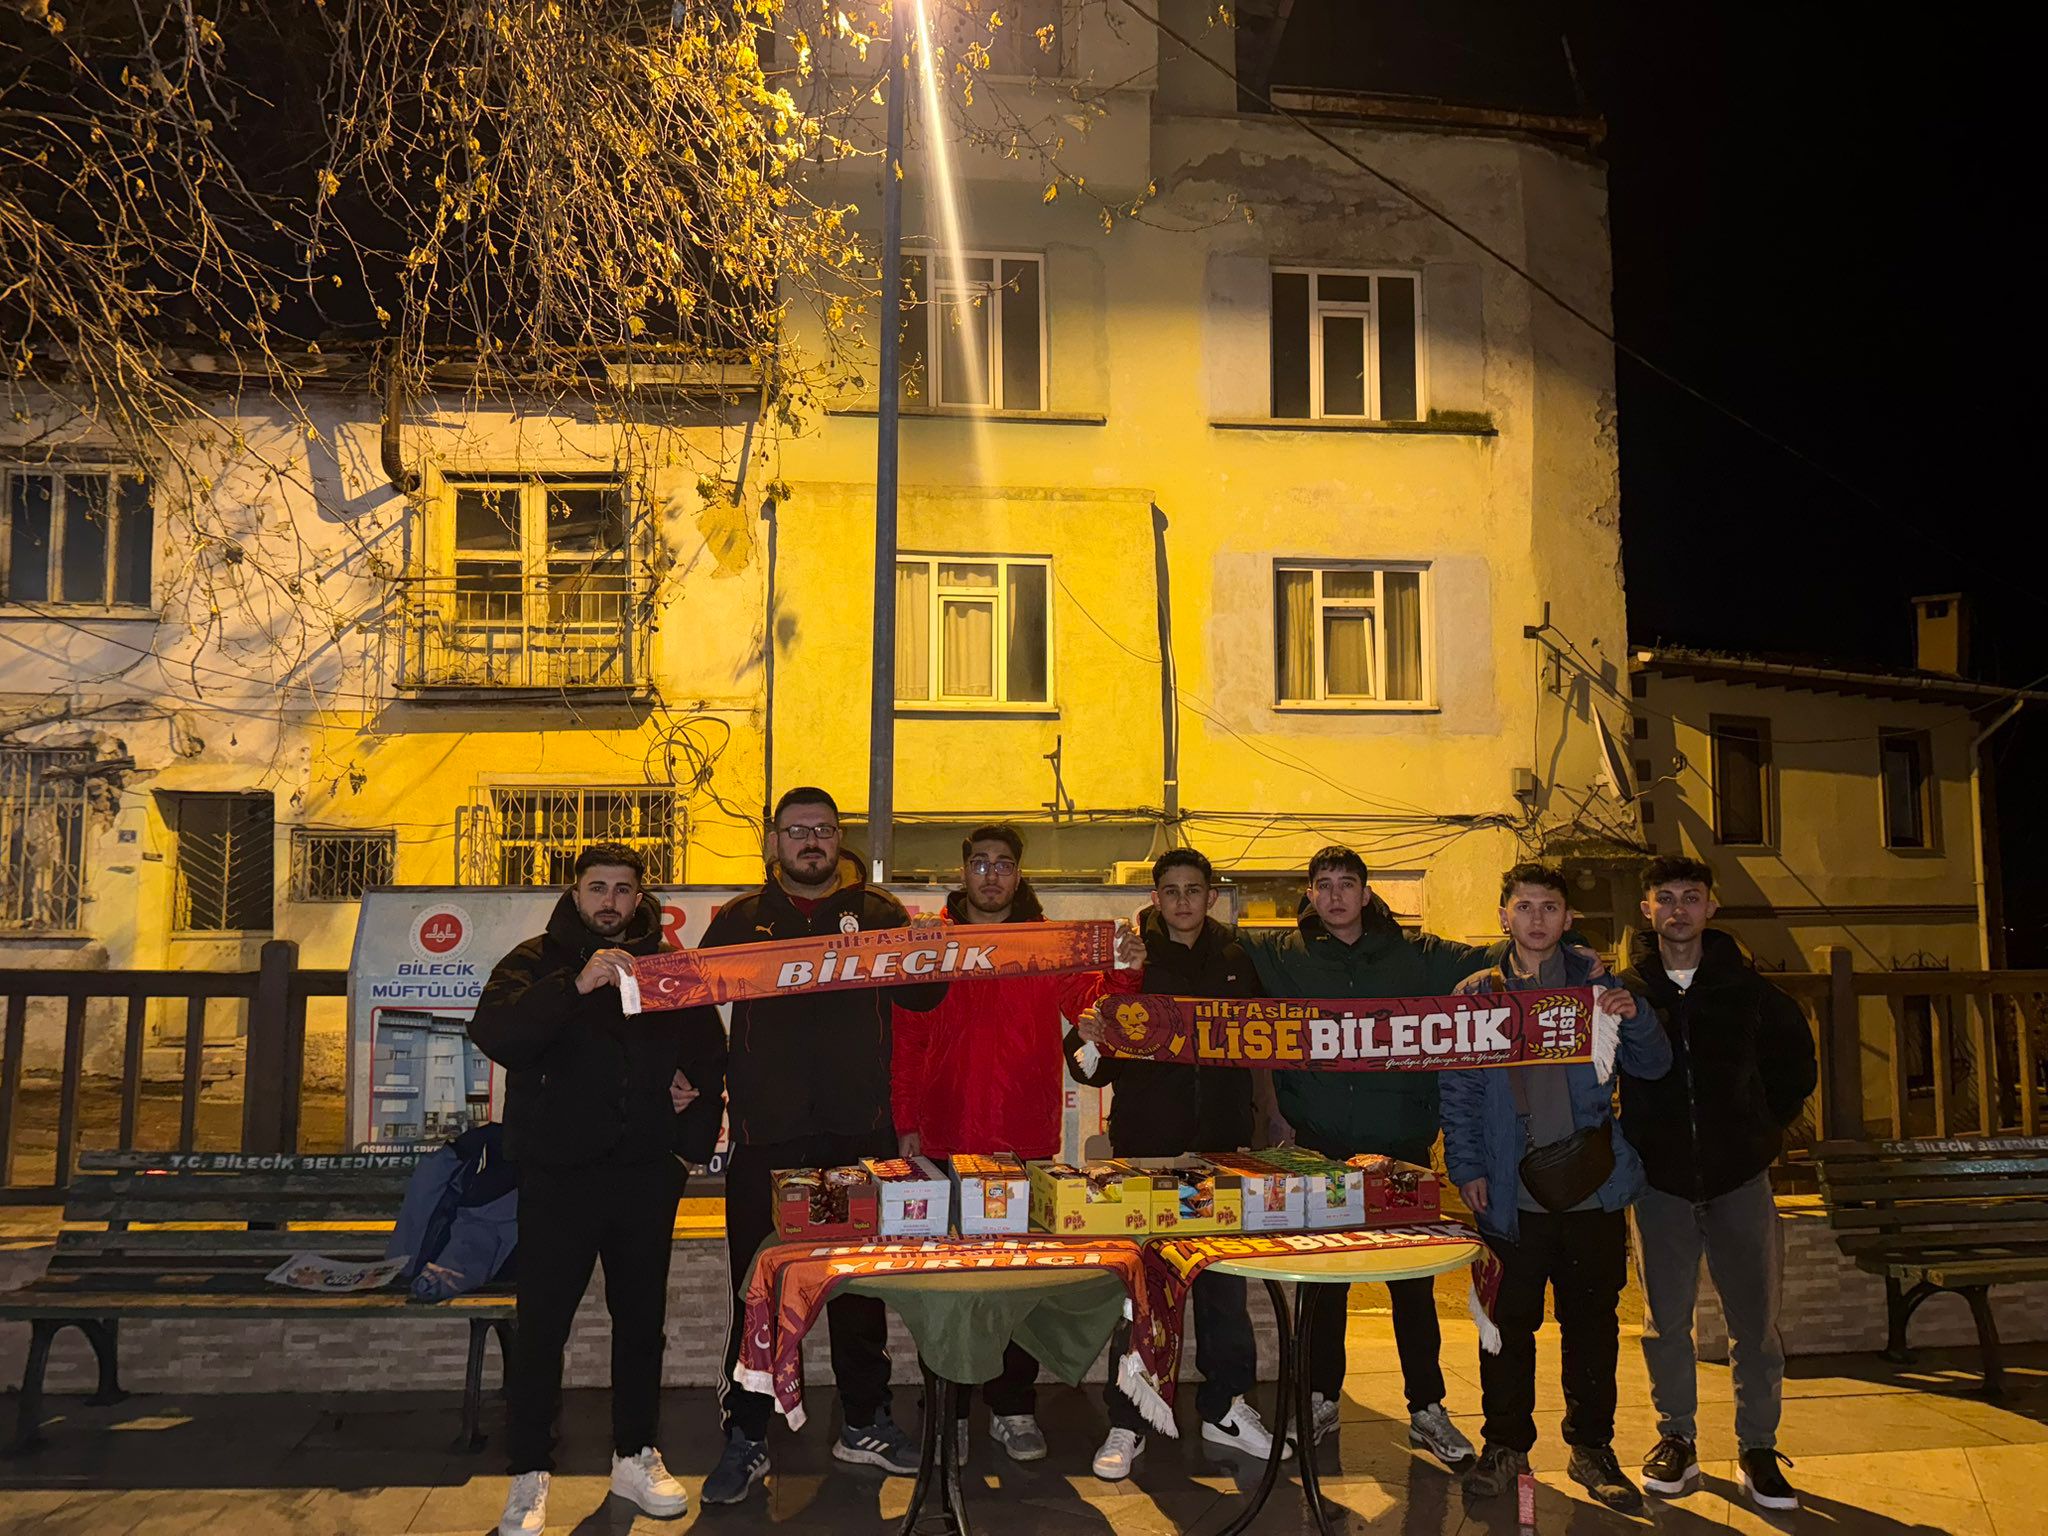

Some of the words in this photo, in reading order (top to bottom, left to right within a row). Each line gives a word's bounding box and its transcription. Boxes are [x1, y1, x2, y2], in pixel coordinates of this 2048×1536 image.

[827, 929, 943, 949] ultrAslan
[398, 960, 475, 976] BİLECİK
[776, 941, 999, 989] BİLECİK
[372, 981, 482, 998] MÜFTÜLÜĞ
[1195, 1001, 1320, 1019] ultrAslan
[1196, 1020, 1304, 1060] LİSE
[1308, 1004, 1512, 1060] BİLECİK
[170, 1156, 207, 1169] T.C.
[213, 1153, 295, 1170] BİLECİK
